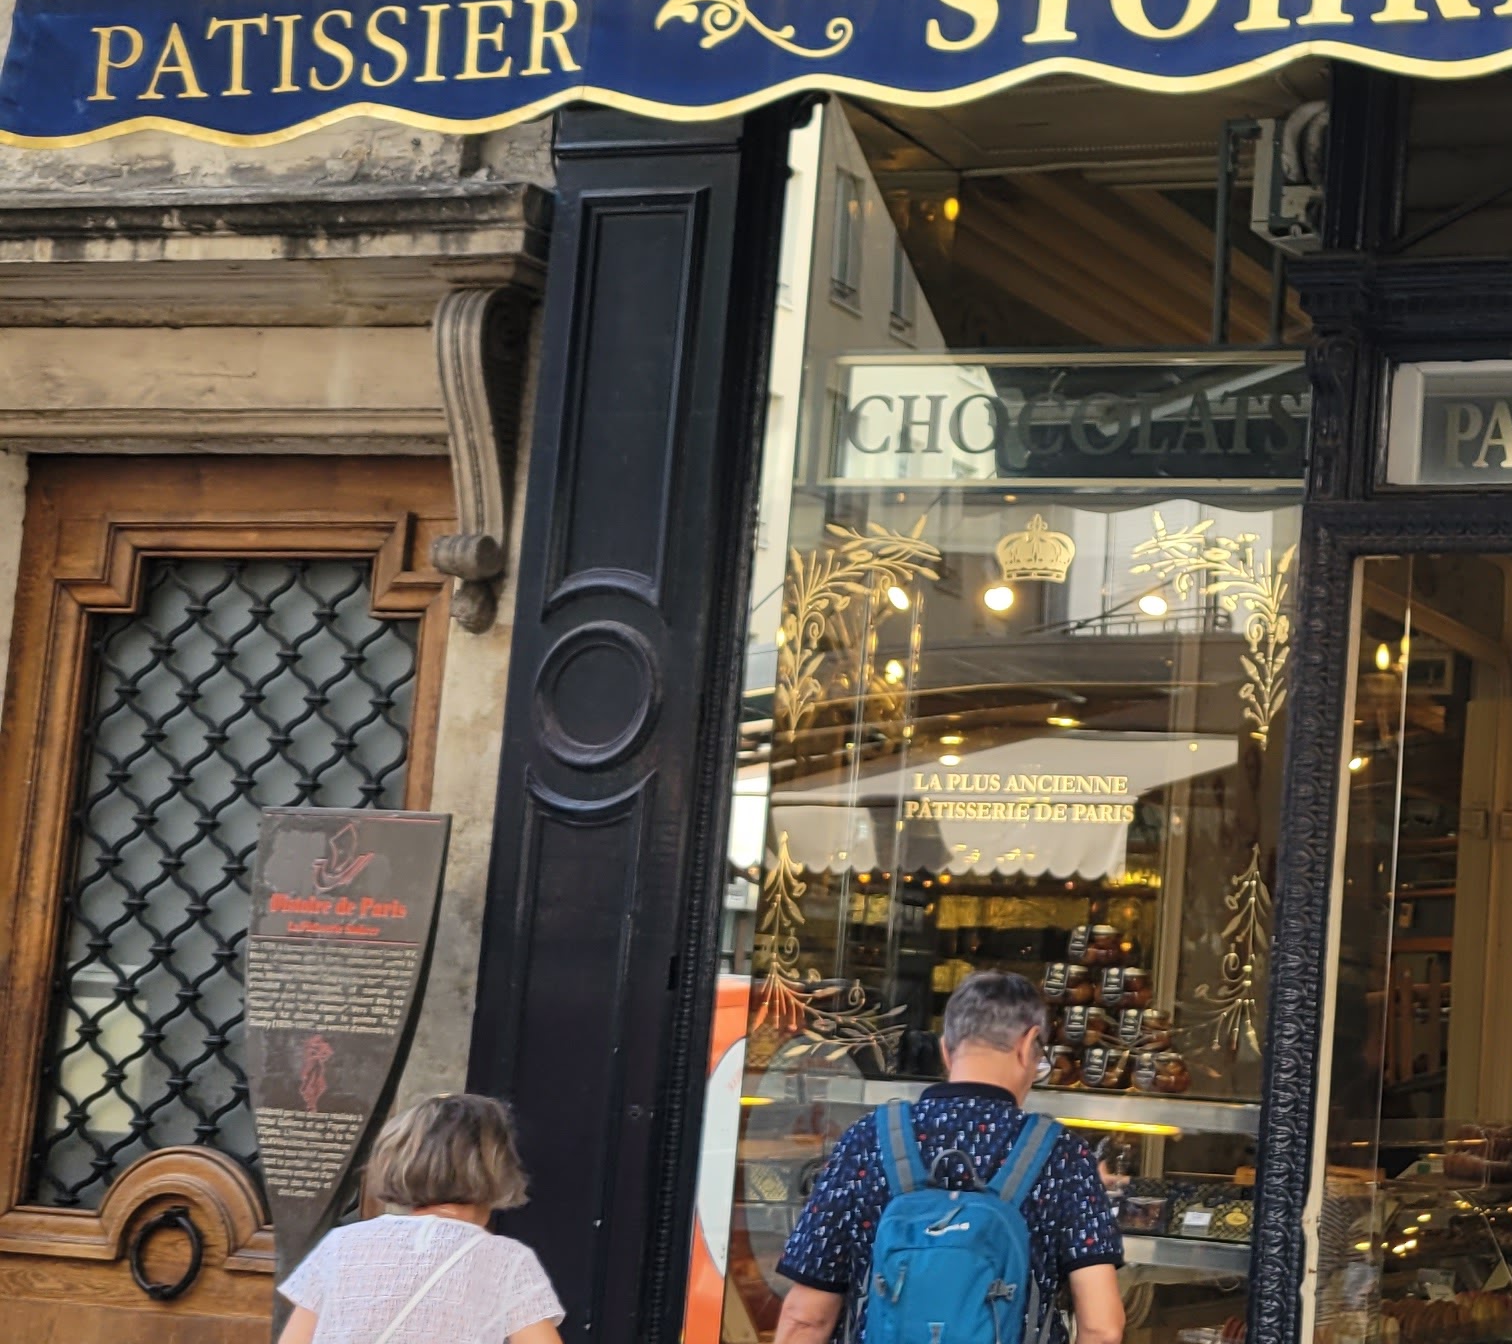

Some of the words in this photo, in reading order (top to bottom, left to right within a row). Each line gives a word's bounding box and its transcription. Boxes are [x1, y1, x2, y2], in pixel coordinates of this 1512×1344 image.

[846, 389, 1301, 455] CHOCOLATS
[912, 772, 942, 792] LA
[947, 772, 1001, 793] PLUS
[1004, 773, 1129, 795] ANCIENNE
[904, 796, 1031, 821] PÂTISSERIE
[1034, 803, 1068, 823] DE
[1071, 803, 1135, 824] PARIS
